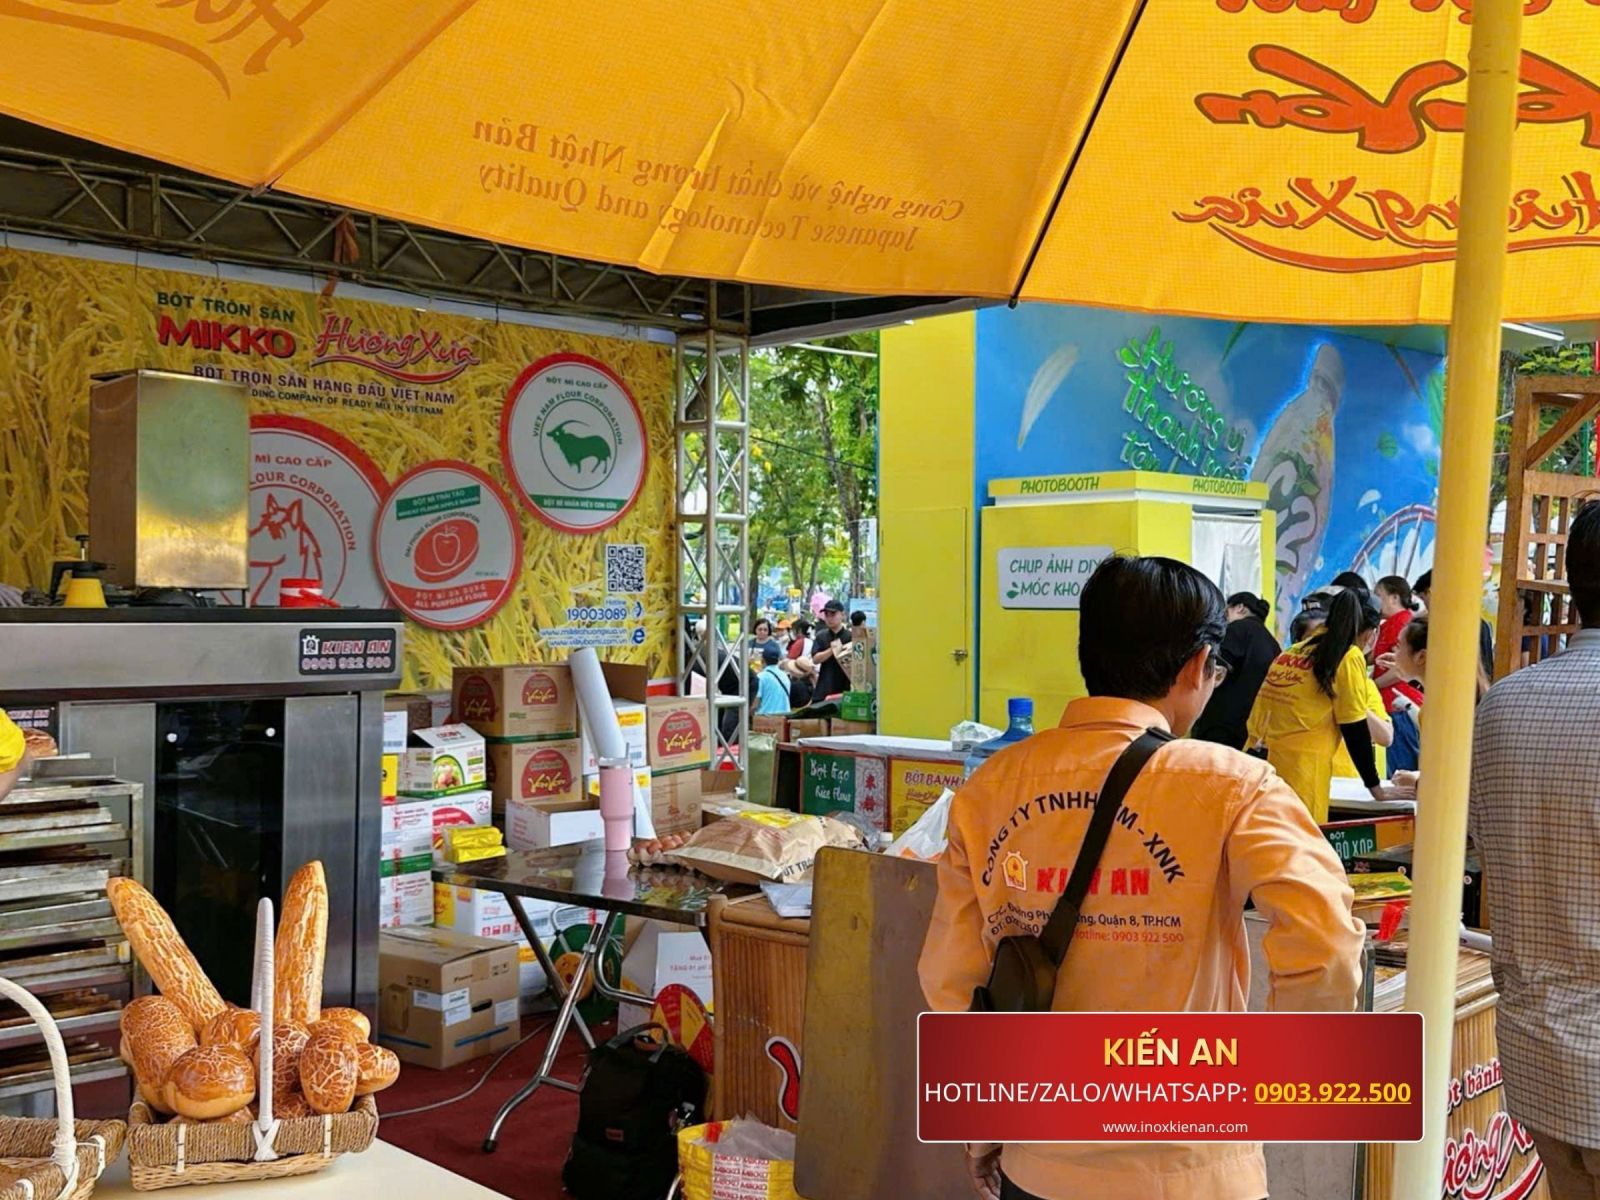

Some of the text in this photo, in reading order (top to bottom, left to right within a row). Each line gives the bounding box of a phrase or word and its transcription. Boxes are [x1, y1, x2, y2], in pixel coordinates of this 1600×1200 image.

[158, 315, 296, 358] MIKKO
[278, 391, 323, 404] COMPANY
[327, 396, 338, 405] OF
[342, 398, 371, 409] READY
[375, 401, 391, 411] MIX
[395, 403, 404, 412] IN
[406, 405, 443, 416] VIETNAM
[425, 391, 455, 405] NAM
[556, 390, 582, 400] FLOUR
[584, 393, 622, 445] CORPORATION
[275, 455, 302, 466] CAO
[1020, 476, 1100, 494] PHOTOBOOTH
[1192, 478, 1247, 494] PHOTOBOOTH
[289, 474, 356, 551] CORPORATION
[1046, 553, 1073, 574] ẢNH
[1020, 577, 1051, 596] MÓC
[567, 607, 627, 620] 19003089
[367, 640, 392, 654] AN
[815, 785, 852, 802] Rice Flour
[479, 801, 490, 811] 24
[1009, 803, 1030, 828] TY
[1035, 791, 1098, 814] TNHH
[1143, 832, 1186, 884] XNK
[1111, 868, 1151, 896] AN
[1098, 913, 1126, 929] Quận
[1129, 915, 1140, 928] 8,
[1142, 914, 1181, 928] TP.HCM
[1112, 931, 1139, 943] 0903
[1141, 931, 1160, 943] 922
[1162, 932, 1184, 943] 500
